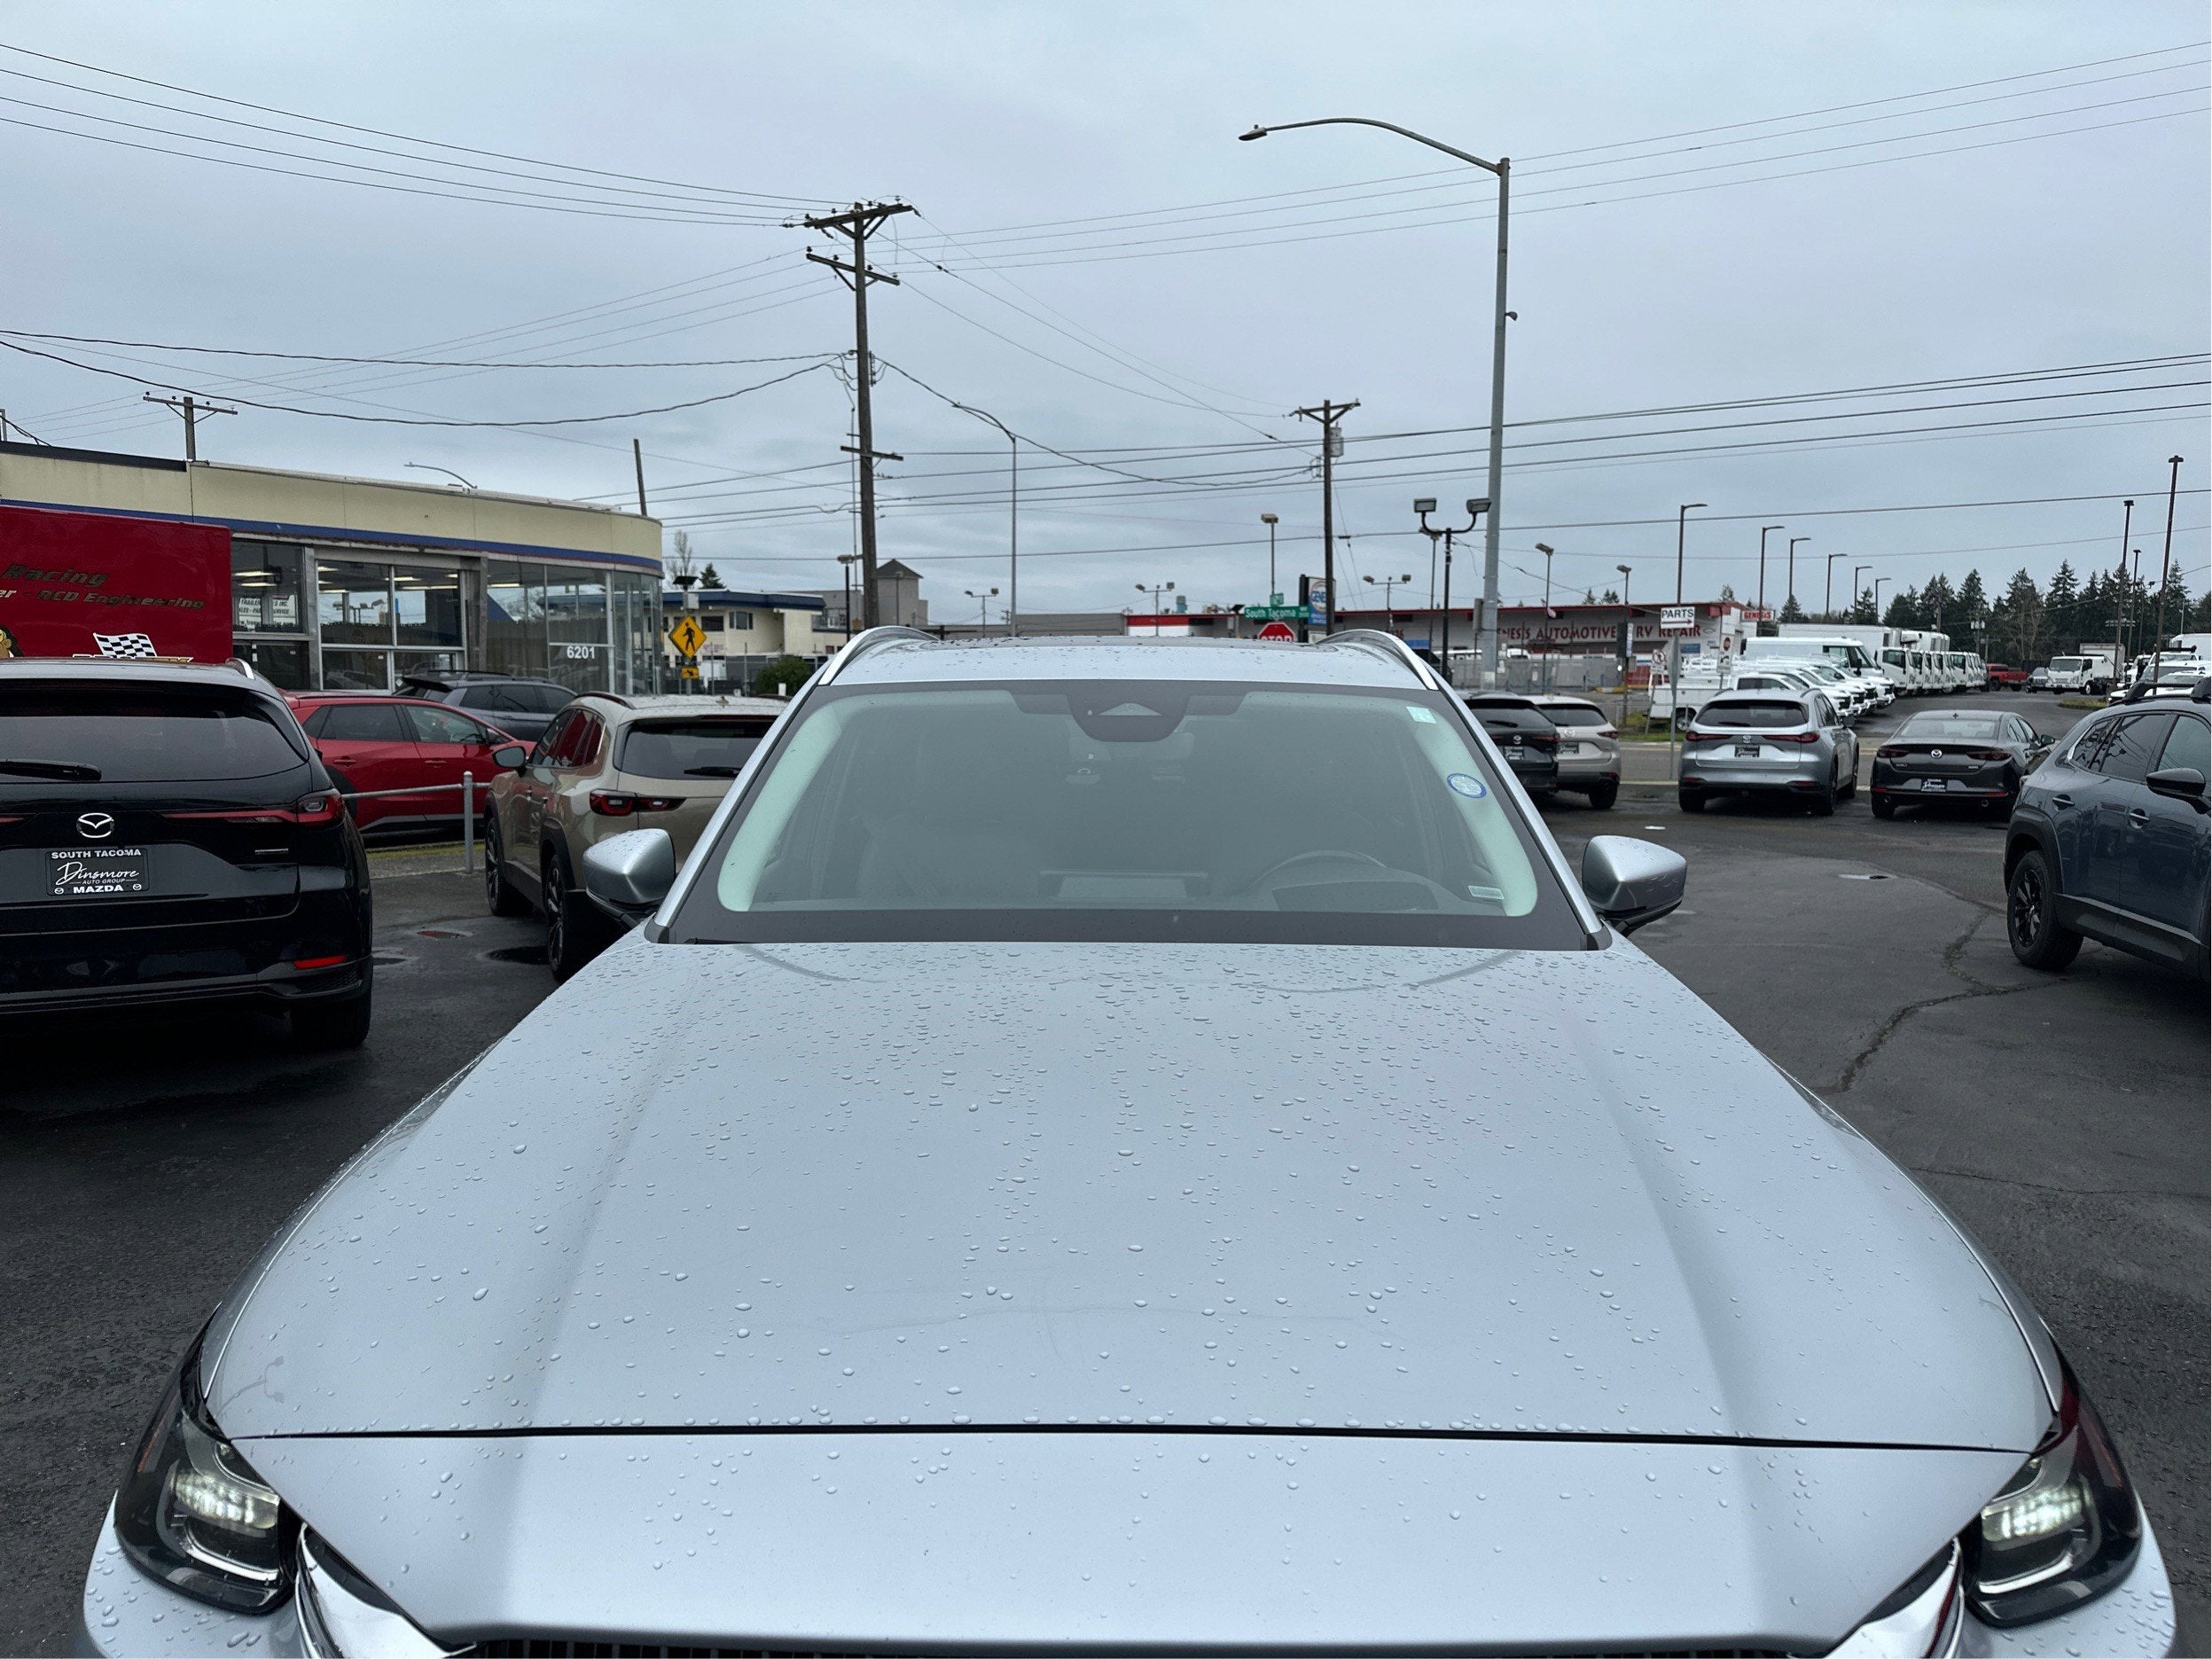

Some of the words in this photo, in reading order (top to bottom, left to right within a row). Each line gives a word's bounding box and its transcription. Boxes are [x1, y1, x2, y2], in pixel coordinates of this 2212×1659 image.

[2, 564, 108, 588] Racing
[1245, 609, 1266, 618] South
[1268, 608, 1296, 618] Tacoma
[1661, 609, 1694, 618] PARTS
[1536, 625, 1616, 640] AUTOMOTIVE
[1636, 626, 1653, 638] RV
[567, 646, 595, 660] 6201
[94, 849, 142, 857] TACOMA
[56, 861, 139, 886] Dinsmore
[73, 885, 124, 894] MAZDA
